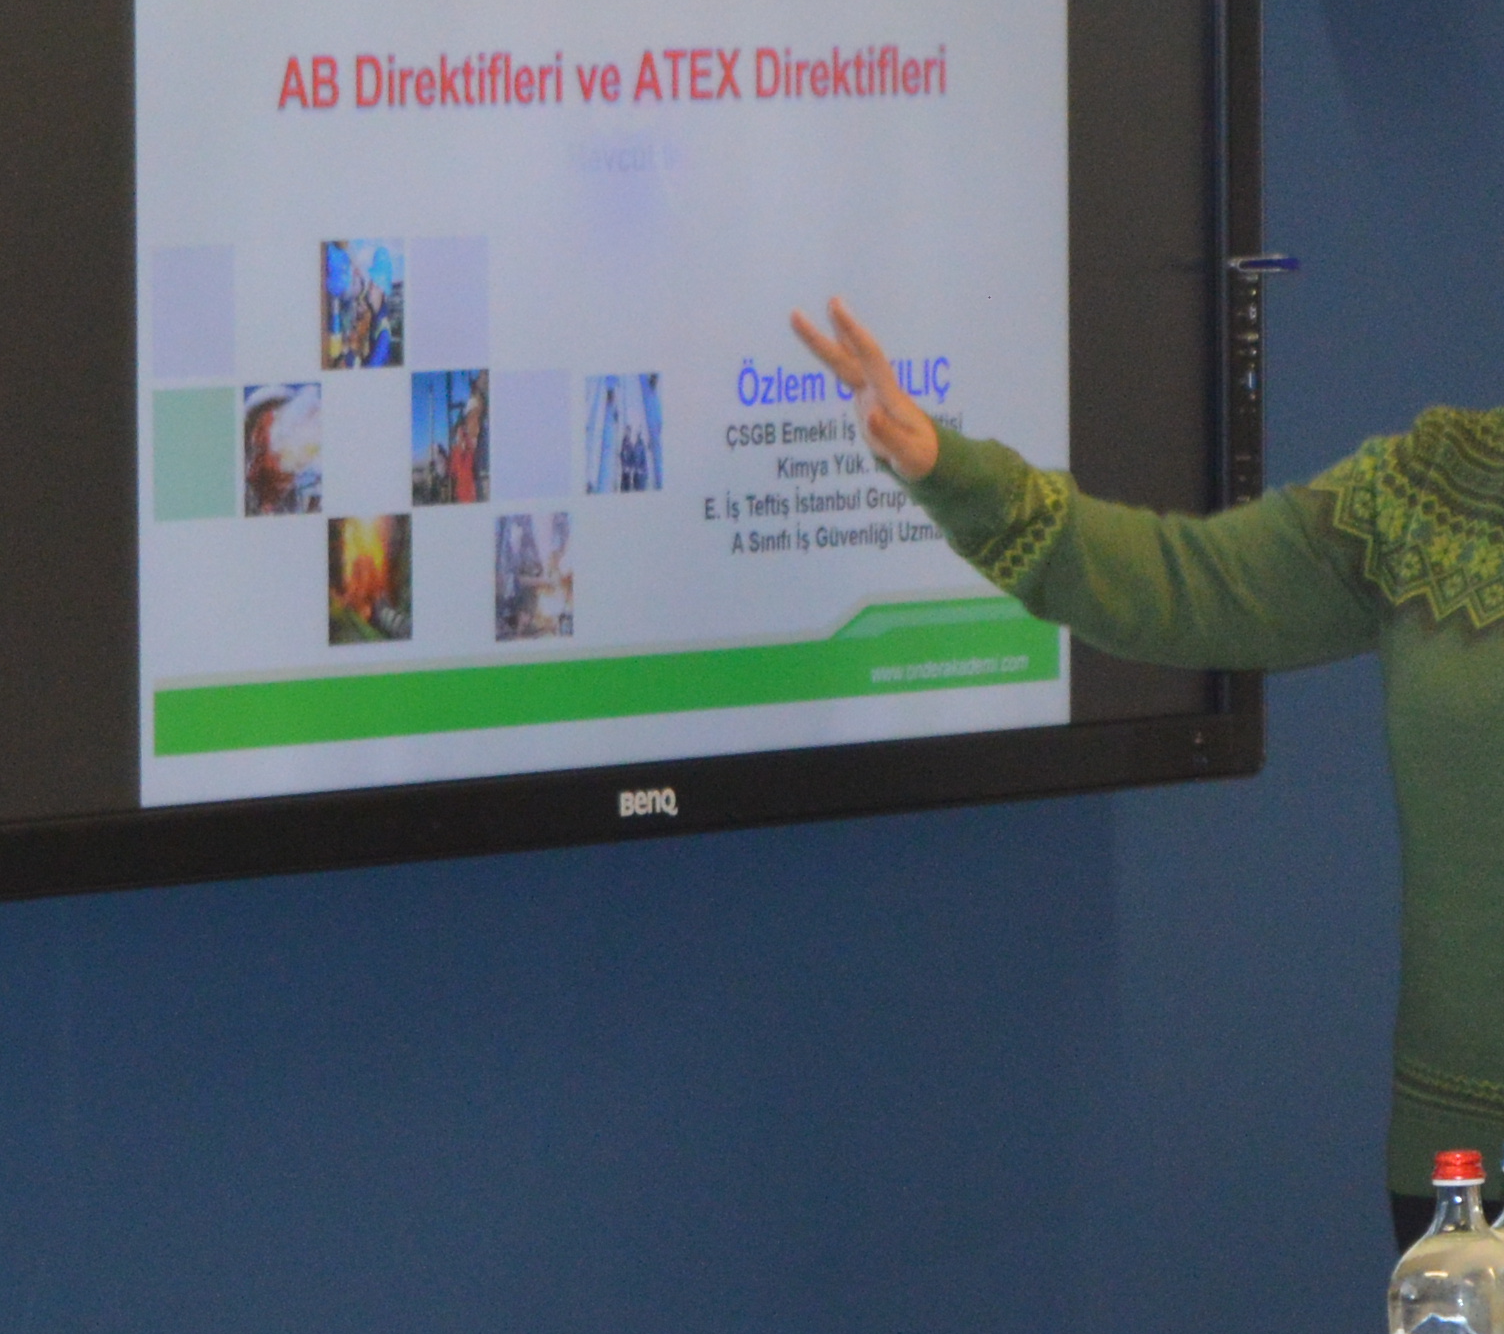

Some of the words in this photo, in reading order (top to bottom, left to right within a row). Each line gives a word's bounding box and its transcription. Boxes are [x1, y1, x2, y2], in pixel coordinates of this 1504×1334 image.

[278, 54, 340, 109] AB
[355, 50, 563, 108] Direktifleri
[575, 62, 621, 103] ve
[633, 47, 742, 101] ATEX
[754, 44, 947, 98] Direktifleri
[737, 358, 826, 407] Özlem
[726, 422, 776, 450] ÇSGB
[782, 417, 837, 446] Emekli
[777, 456, 829, 483] Kimya
[704, 497, 721, 520] E.
[725, 489, 740, 523] İş
[745, 494, 790, 519] Teftiş
[795, 485, 861, 514] İstanbul
[866, 488, 907, 512] Grup
[732, 531, 744, 556] A
[816, 520, 895, 550] Güvenliği
[619, 787, 679, 817] BenQ
